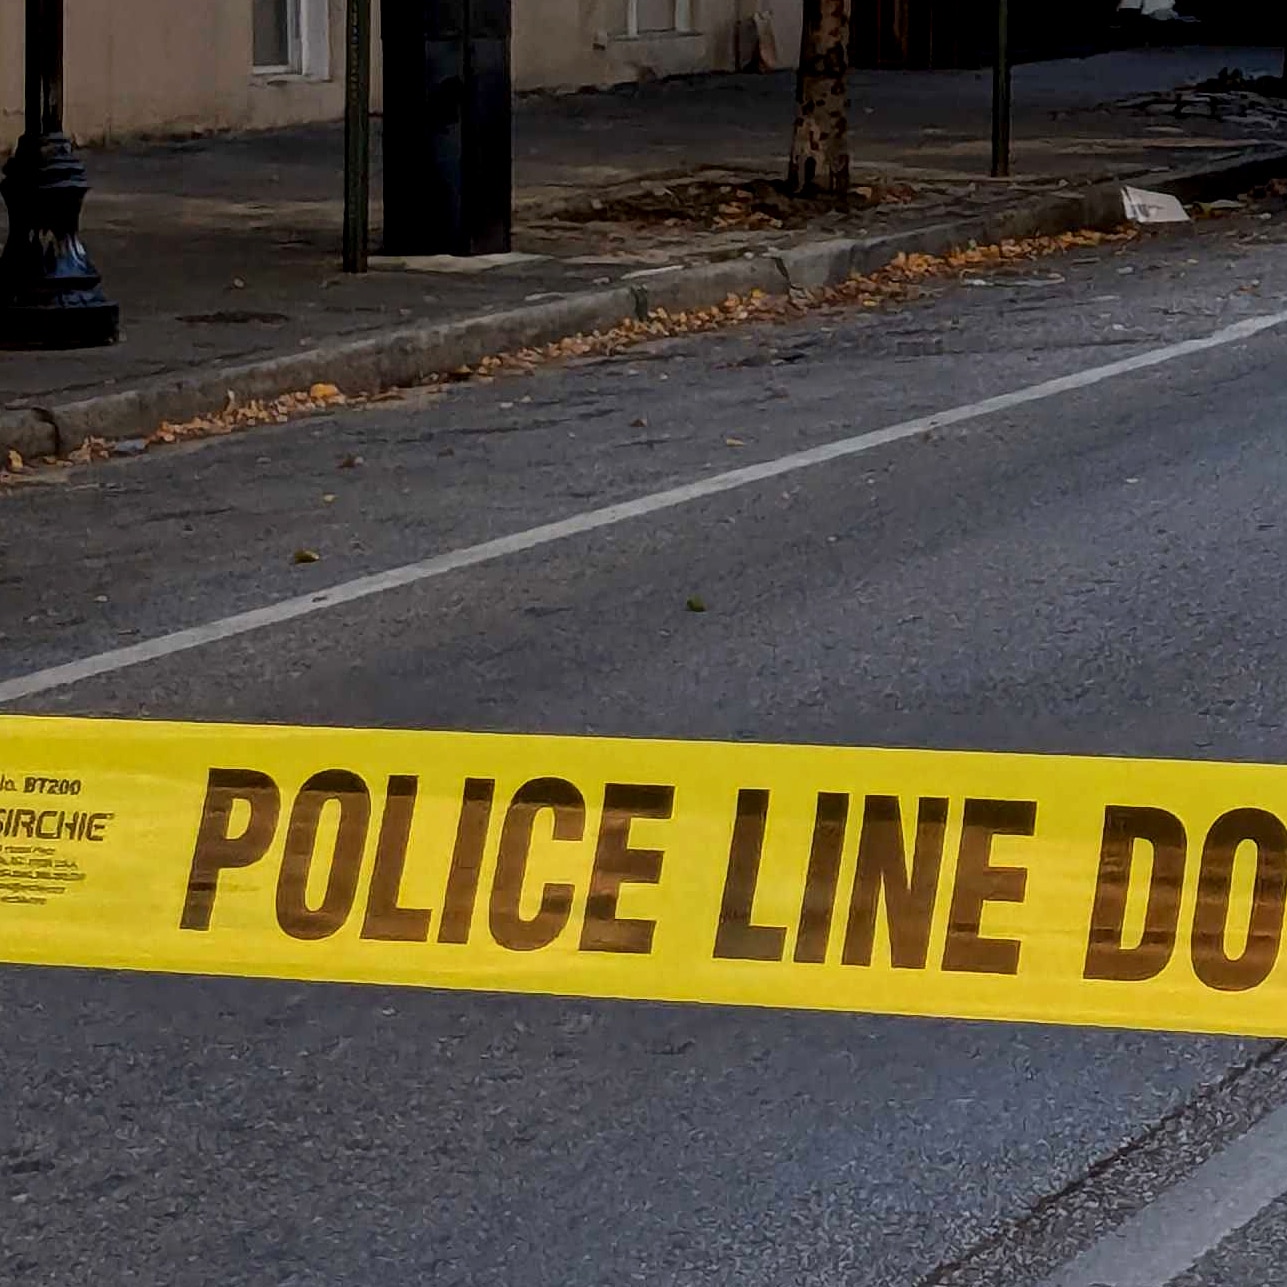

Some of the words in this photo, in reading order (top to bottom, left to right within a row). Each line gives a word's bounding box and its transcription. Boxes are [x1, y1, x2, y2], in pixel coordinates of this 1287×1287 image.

[23, 776, 82, 796] BT200
[179, 767, 675, 954] POLICE
[712, 788, 1037, 975] LINE
